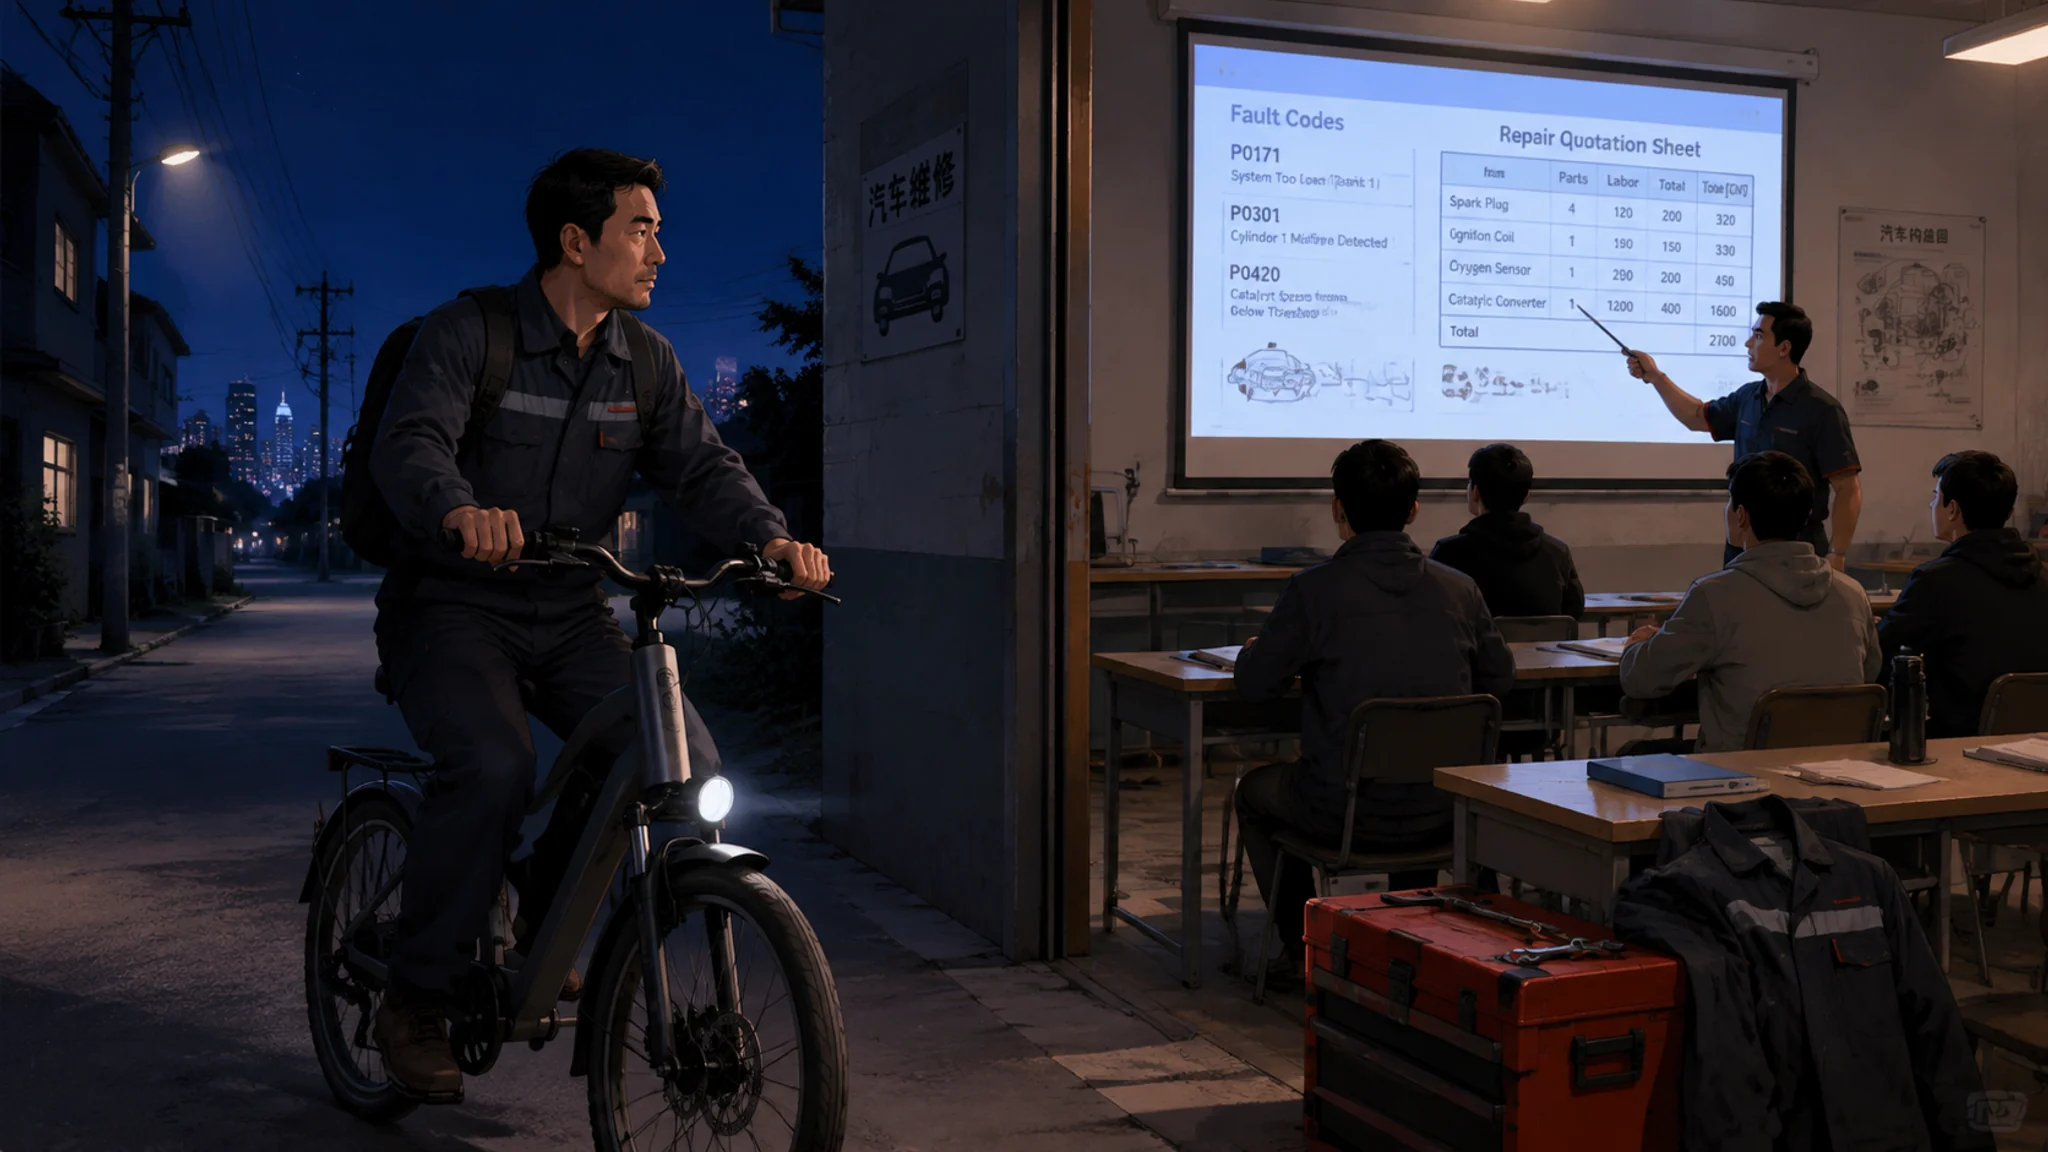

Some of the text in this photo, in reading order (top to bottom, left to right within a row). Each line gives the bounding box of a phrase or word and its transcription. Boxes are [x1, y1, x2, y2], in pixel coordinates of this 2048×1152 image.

[1231, 103, 1345, 131] Fault Codes
[1499, 125, 1701, 158] Repair Quotation Sheet
[1231, 143, 1280, 163] P0171
[1231, 169, 1272, 185] System
[1275, 171, 1297, 185] Too
[1558, 171, 1589, 185] Parts
[1607, 174, 1640, 188] Labor
[1659, 178, 1686, 192] Total
[868, 150, 956, 229] 汽车维修
[1230, 204, 1280, 223] P0301
[1449, 194, 1736, 226] Spark Plug 4 120 200 320
[1281, 232, 1287, 244] 1
[1494, 230, 1515, 243] Coil
[1569, 235, 1575, 247] 1
[1662, 241, 1682, 253] 150
[1715, 243, 1736, 257] 330
[1229, 264, 1281, 283] P0420
[1494, 261, 1532, 276] Sensor
[1569, 266, 1574, 278] 1
[1660, 271, 1682, 284] 200
[1715, 274, 1735, 287] 450
[1569, 298, 1574, 310] 1
[1607, 299, 1634, 313] 1200
[1660, 302, 1682, 315] 400
[1710, 304, 1737, 318] 1600
[1450, 325, 1737, 347] Total 2700
